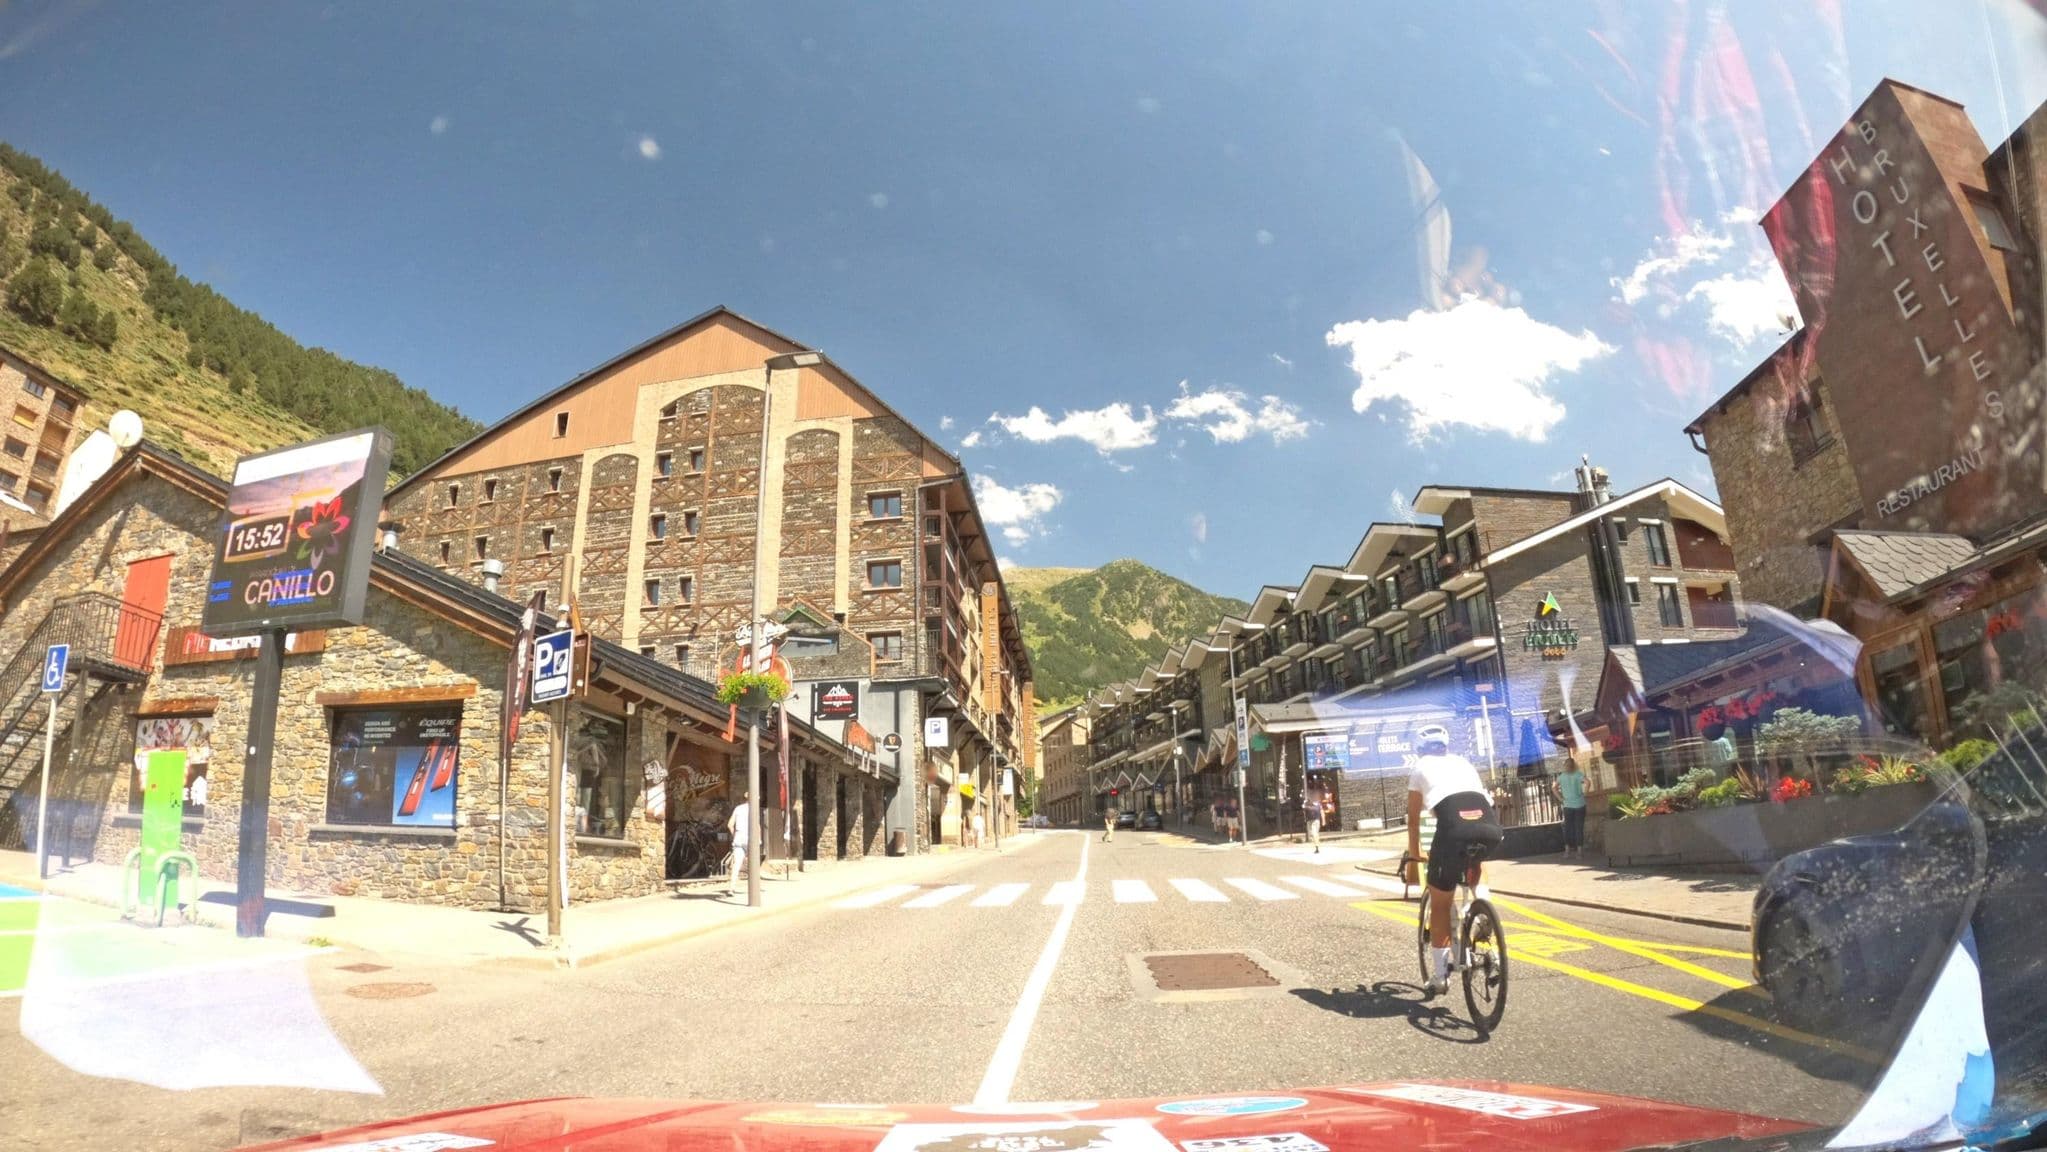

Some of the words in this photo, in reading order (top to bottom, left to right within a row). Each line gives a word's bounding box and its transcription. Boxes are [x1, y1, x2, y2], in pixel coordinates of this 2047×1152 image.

[1830, 145, 1942, 368] HOTEL
[1858, 119, 2005, 418] BRUXELLES
[1876, 446, 1985, 519] RESTAURANT
[235, 523, 284, 552] 15:52
[244, 570, 335, 605] CANILLO
[535, 642, 553, 680] P
